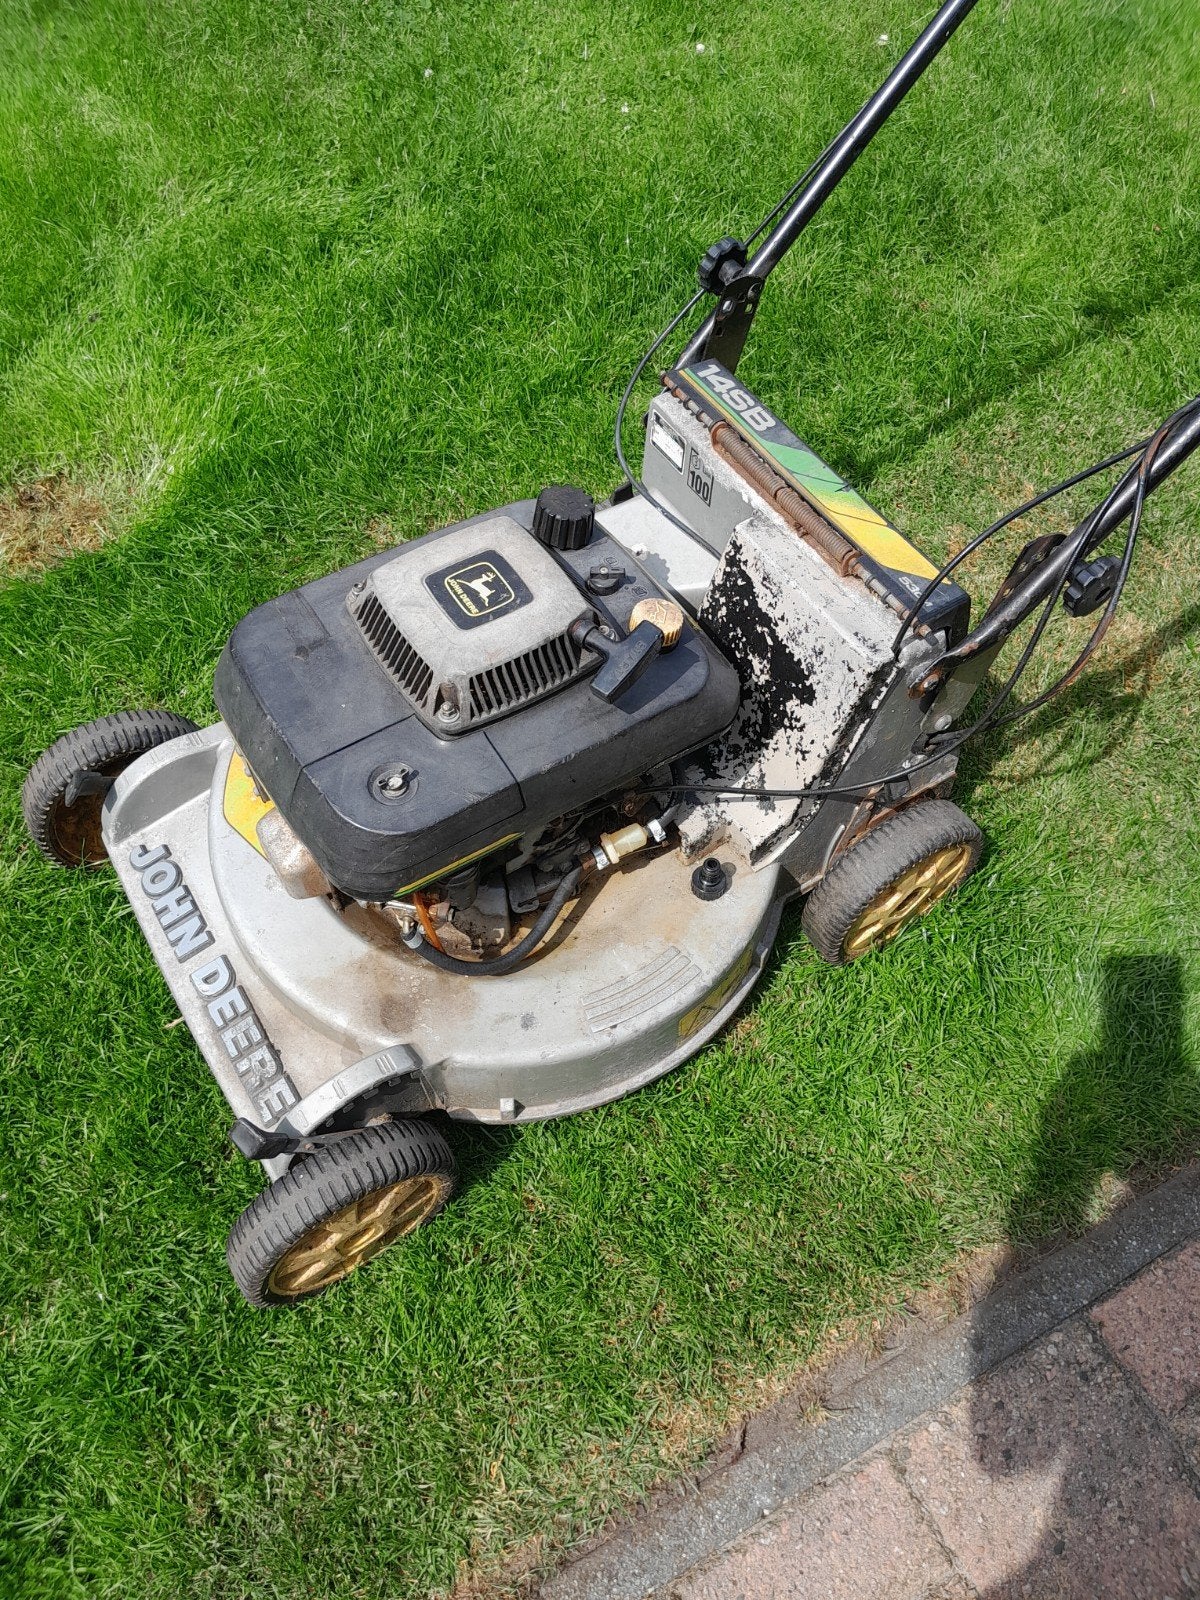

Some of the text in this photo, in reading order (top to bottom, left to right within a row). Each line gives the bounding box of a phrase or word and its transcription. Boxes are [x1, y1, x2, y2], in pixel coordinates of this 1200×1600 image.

[697, 364, 776, 431] 14SB
[690, 471, 709, 501] 100
[447, 578, 480, 614] JOHN DEERE
[129, 844, 302, 1129] JOHN DEERE
